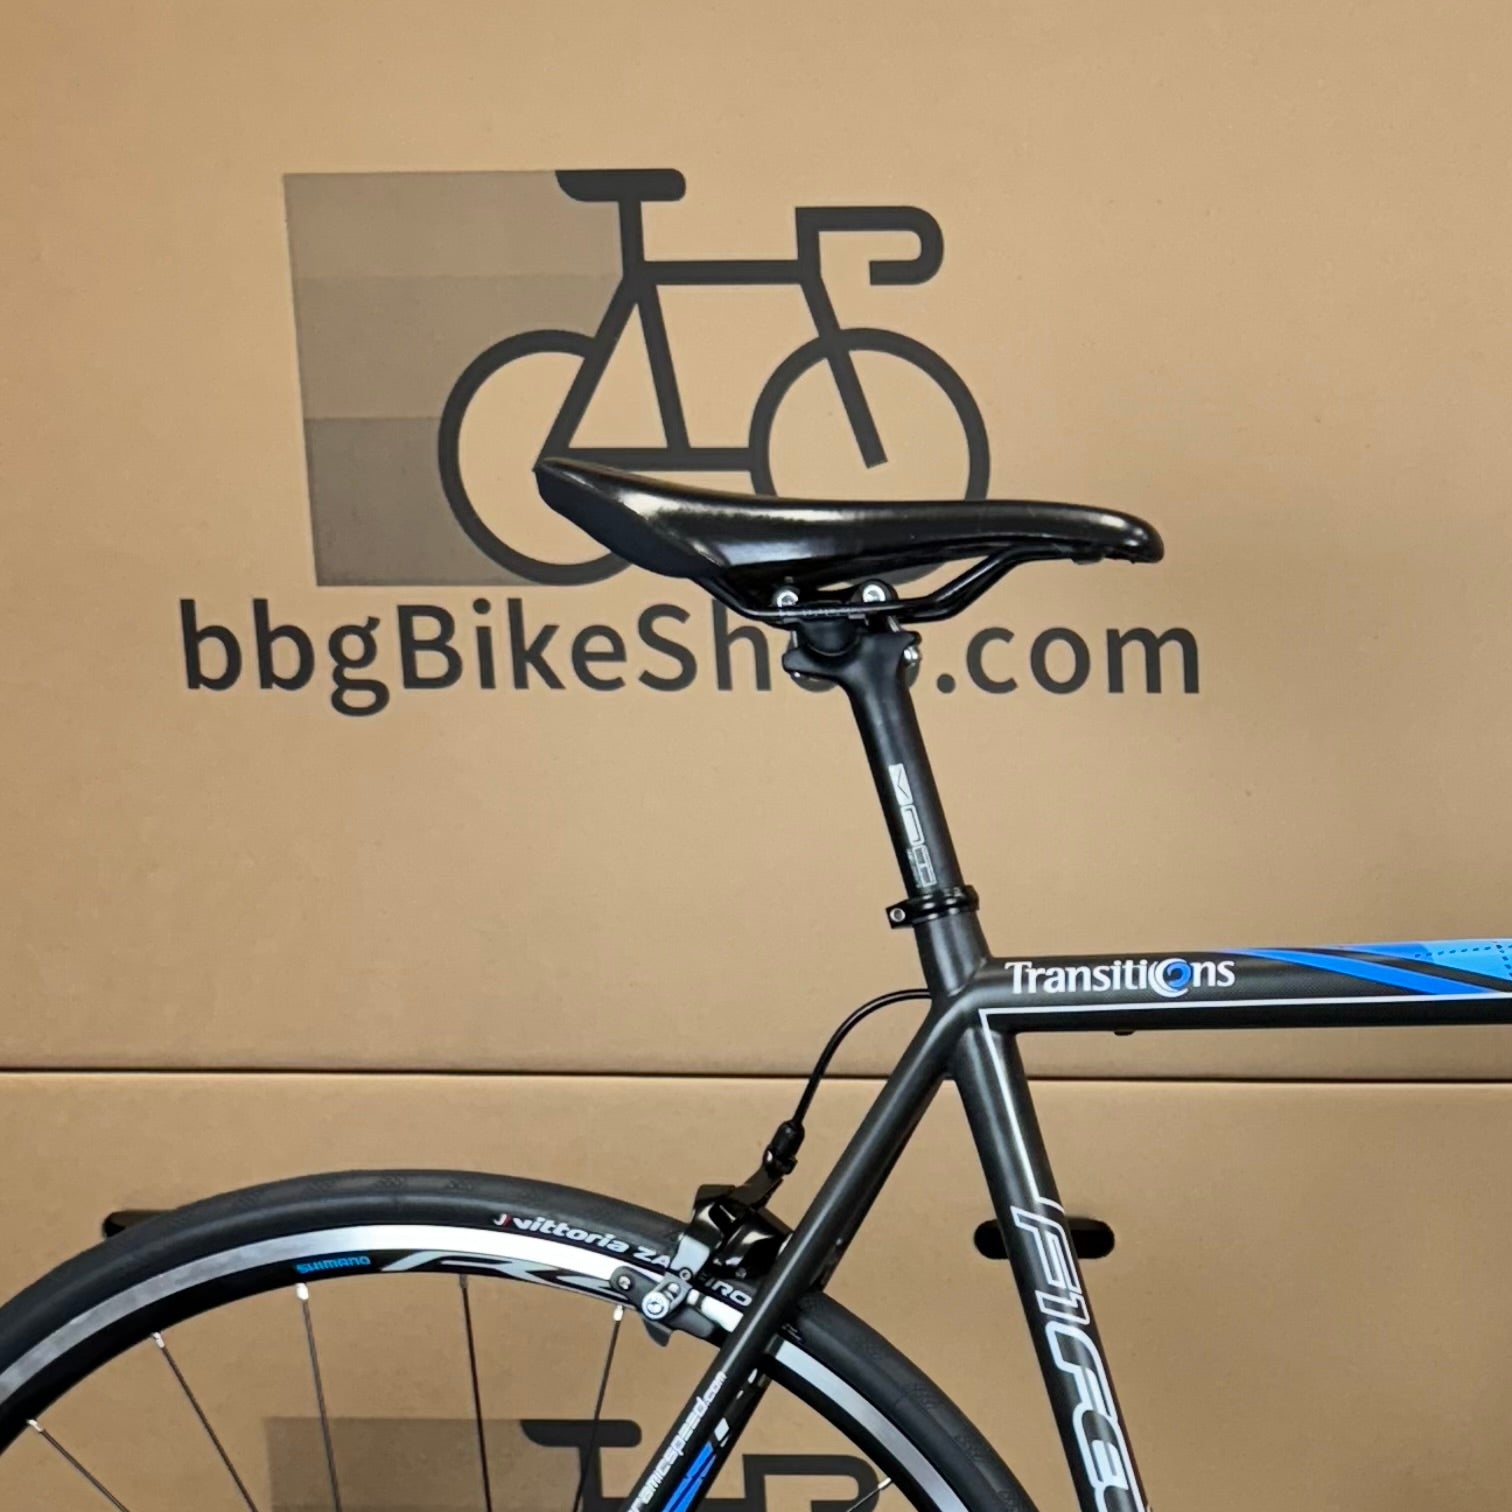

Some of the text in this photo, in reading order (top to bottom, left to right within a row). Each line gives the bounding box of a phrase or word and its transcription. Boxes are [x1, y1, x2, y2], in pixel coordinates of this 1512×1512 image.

[180, 599, 1199, 717] bbgBikeSh.com
[1005, 957, 1236, 998] Transitions
[512, 1215, 629, 1254] vittoria
[295, 1254, 371, 1274] SHIMANO
